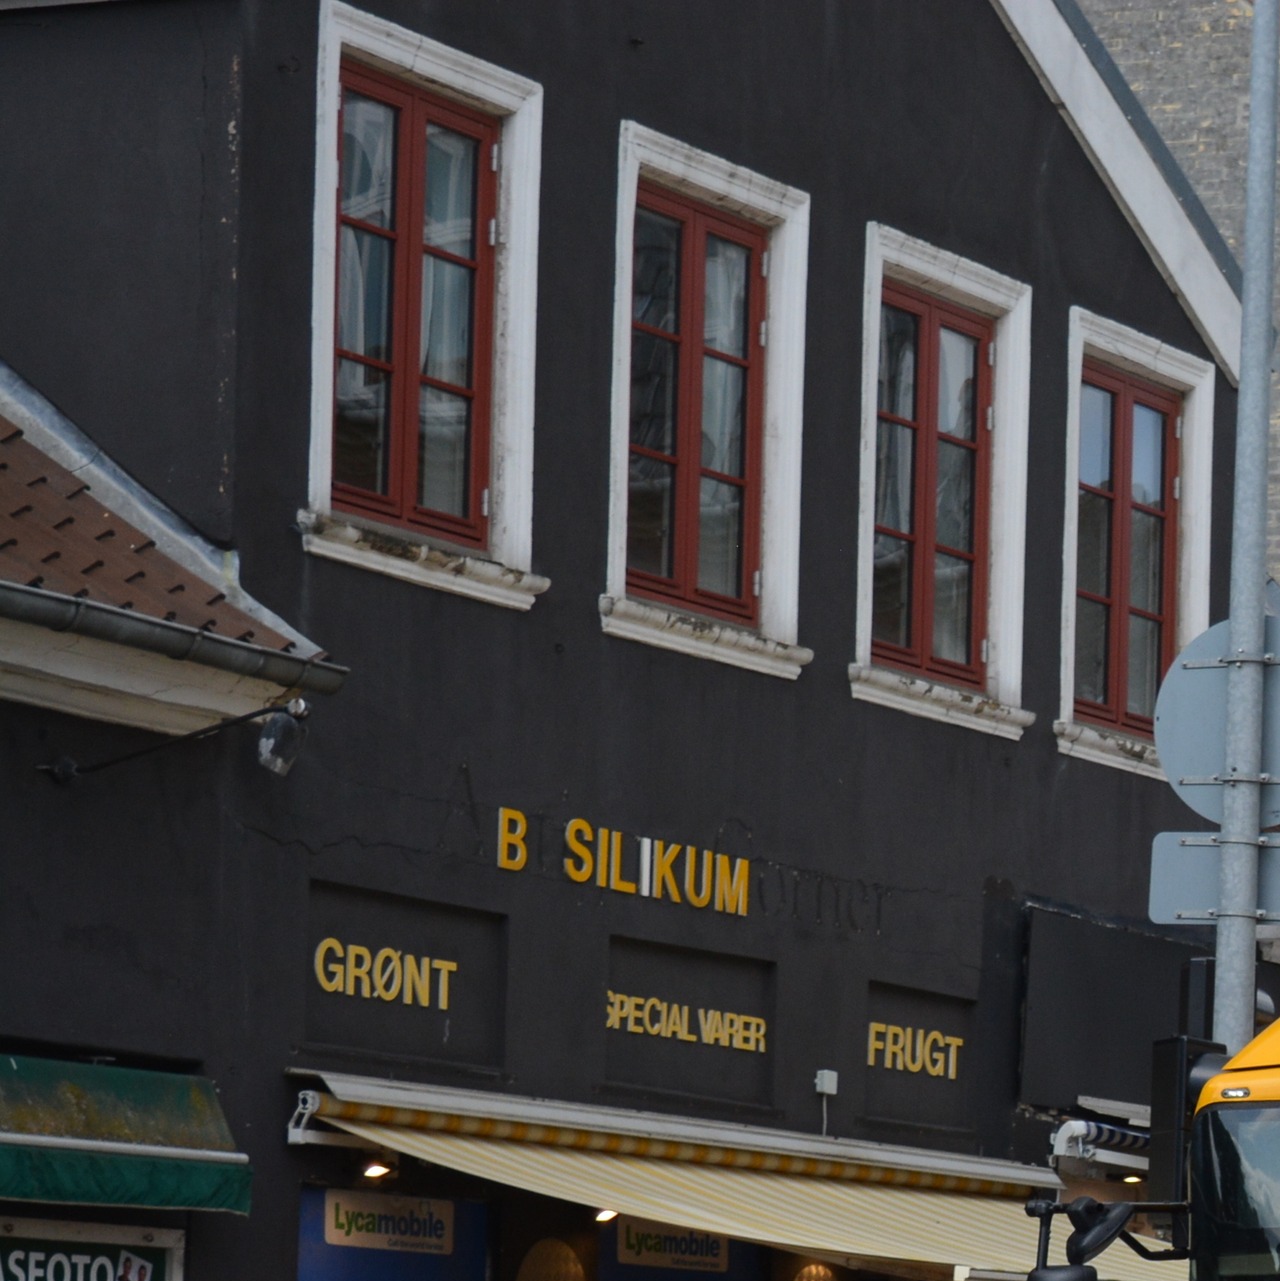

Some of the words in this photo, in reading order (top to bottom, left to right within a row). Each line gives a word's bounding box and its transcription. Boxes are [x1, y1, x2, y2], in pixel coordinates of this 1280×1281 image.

[563, 817, 750, 917] SILIKUM
[314, 937, 457, 1010] GRØNT
[606, 990, 698, 1042] SPECIAL
[698, 1008, 766, 1052] VARER
[867, 1021, 964, 1079] FRUGT
[334, 1202, 446, 1240] Lycamobile
[624, 1224, 720, 1257] Lycamobile
